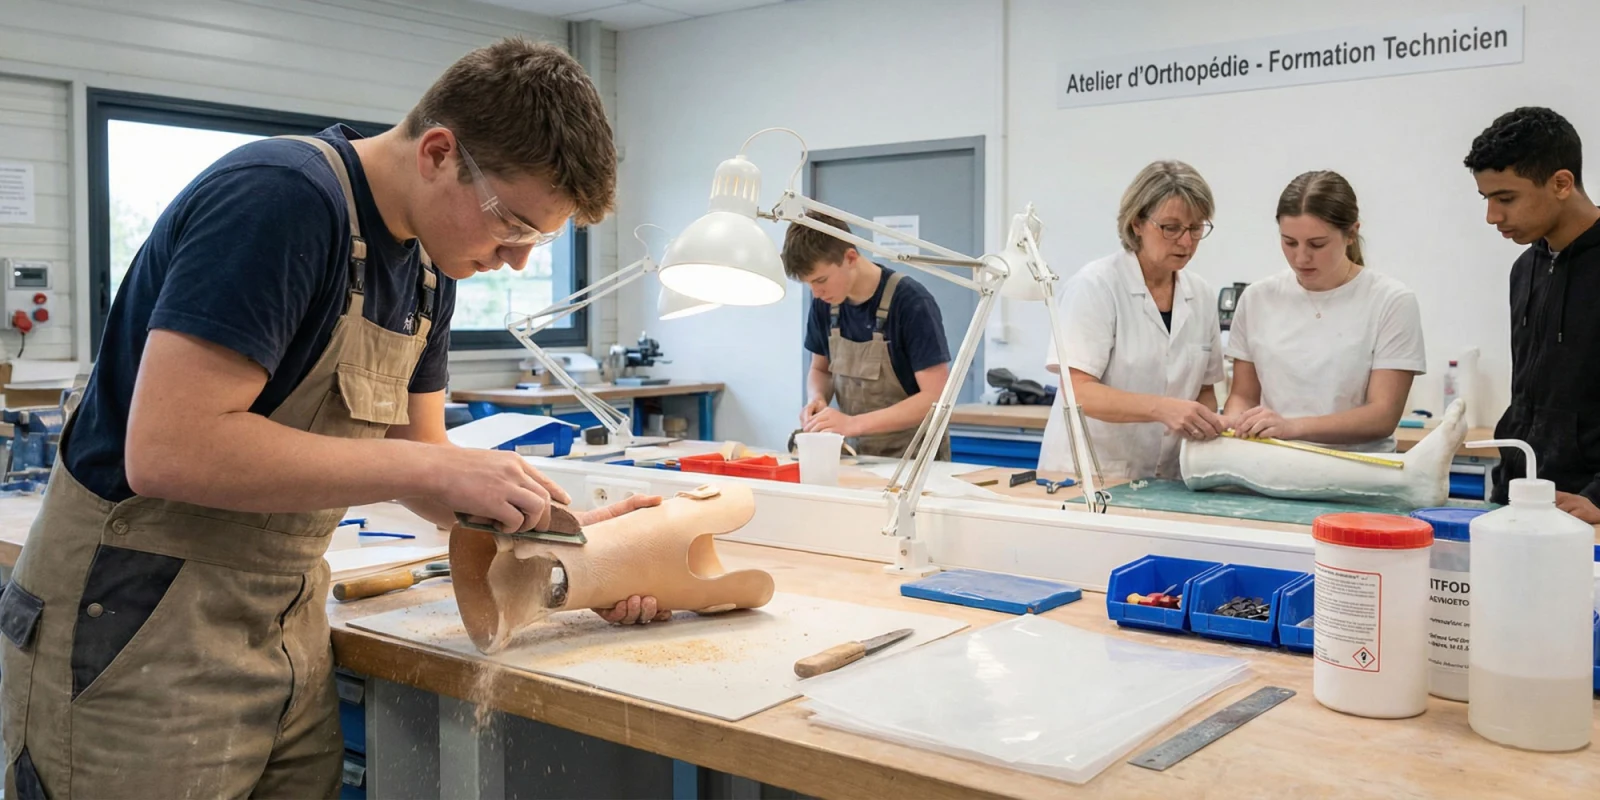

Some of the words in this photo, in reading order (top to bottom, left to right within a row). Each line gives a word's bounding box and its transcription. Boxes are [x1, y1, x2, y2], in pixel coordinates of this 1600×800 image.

[1066, 70, 1123, 95] Atelier
[1269, 42, 1375, 73] Formation
[1383, 26, 1507, 60] Technicien
